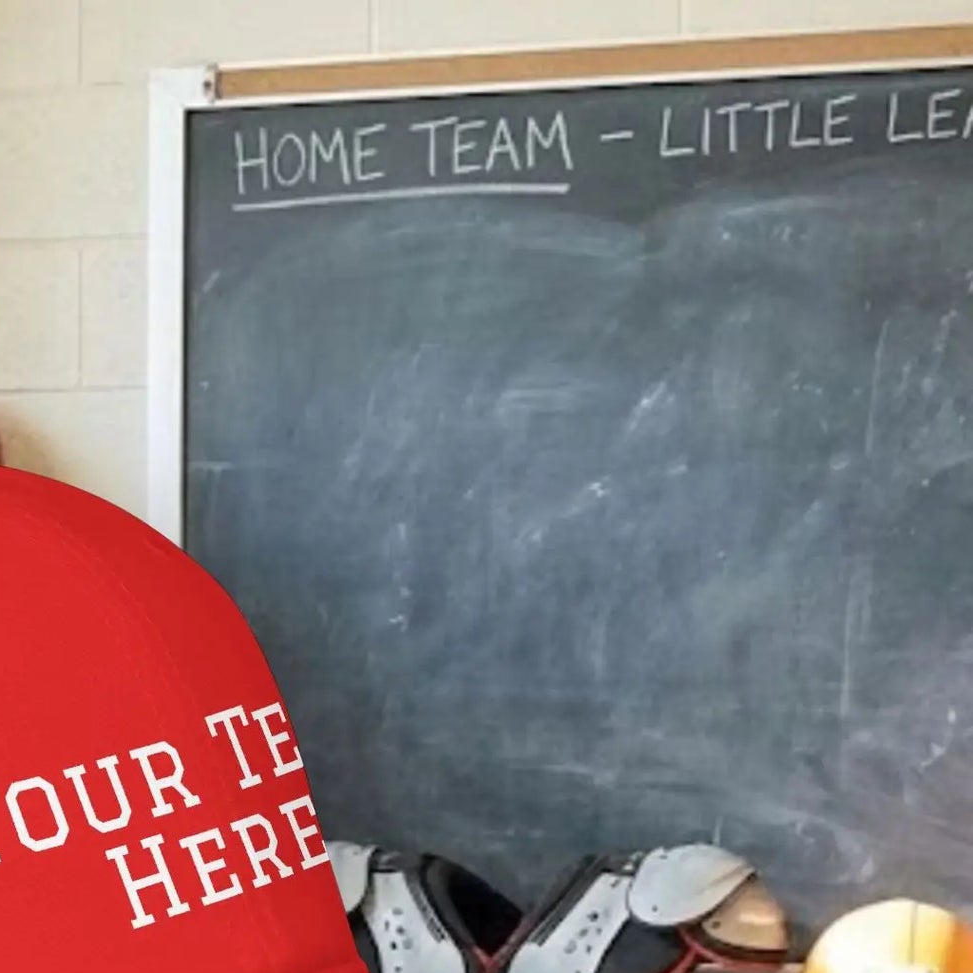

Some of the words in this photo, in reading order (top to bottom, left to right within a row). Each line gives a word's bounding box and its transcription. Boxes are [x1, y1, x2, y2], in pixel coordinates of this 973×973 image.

[234, 123, 386, 194] HOME
[410, 111, 573, 178] TEAM
[658, 95, 857, 157] LITTLE
